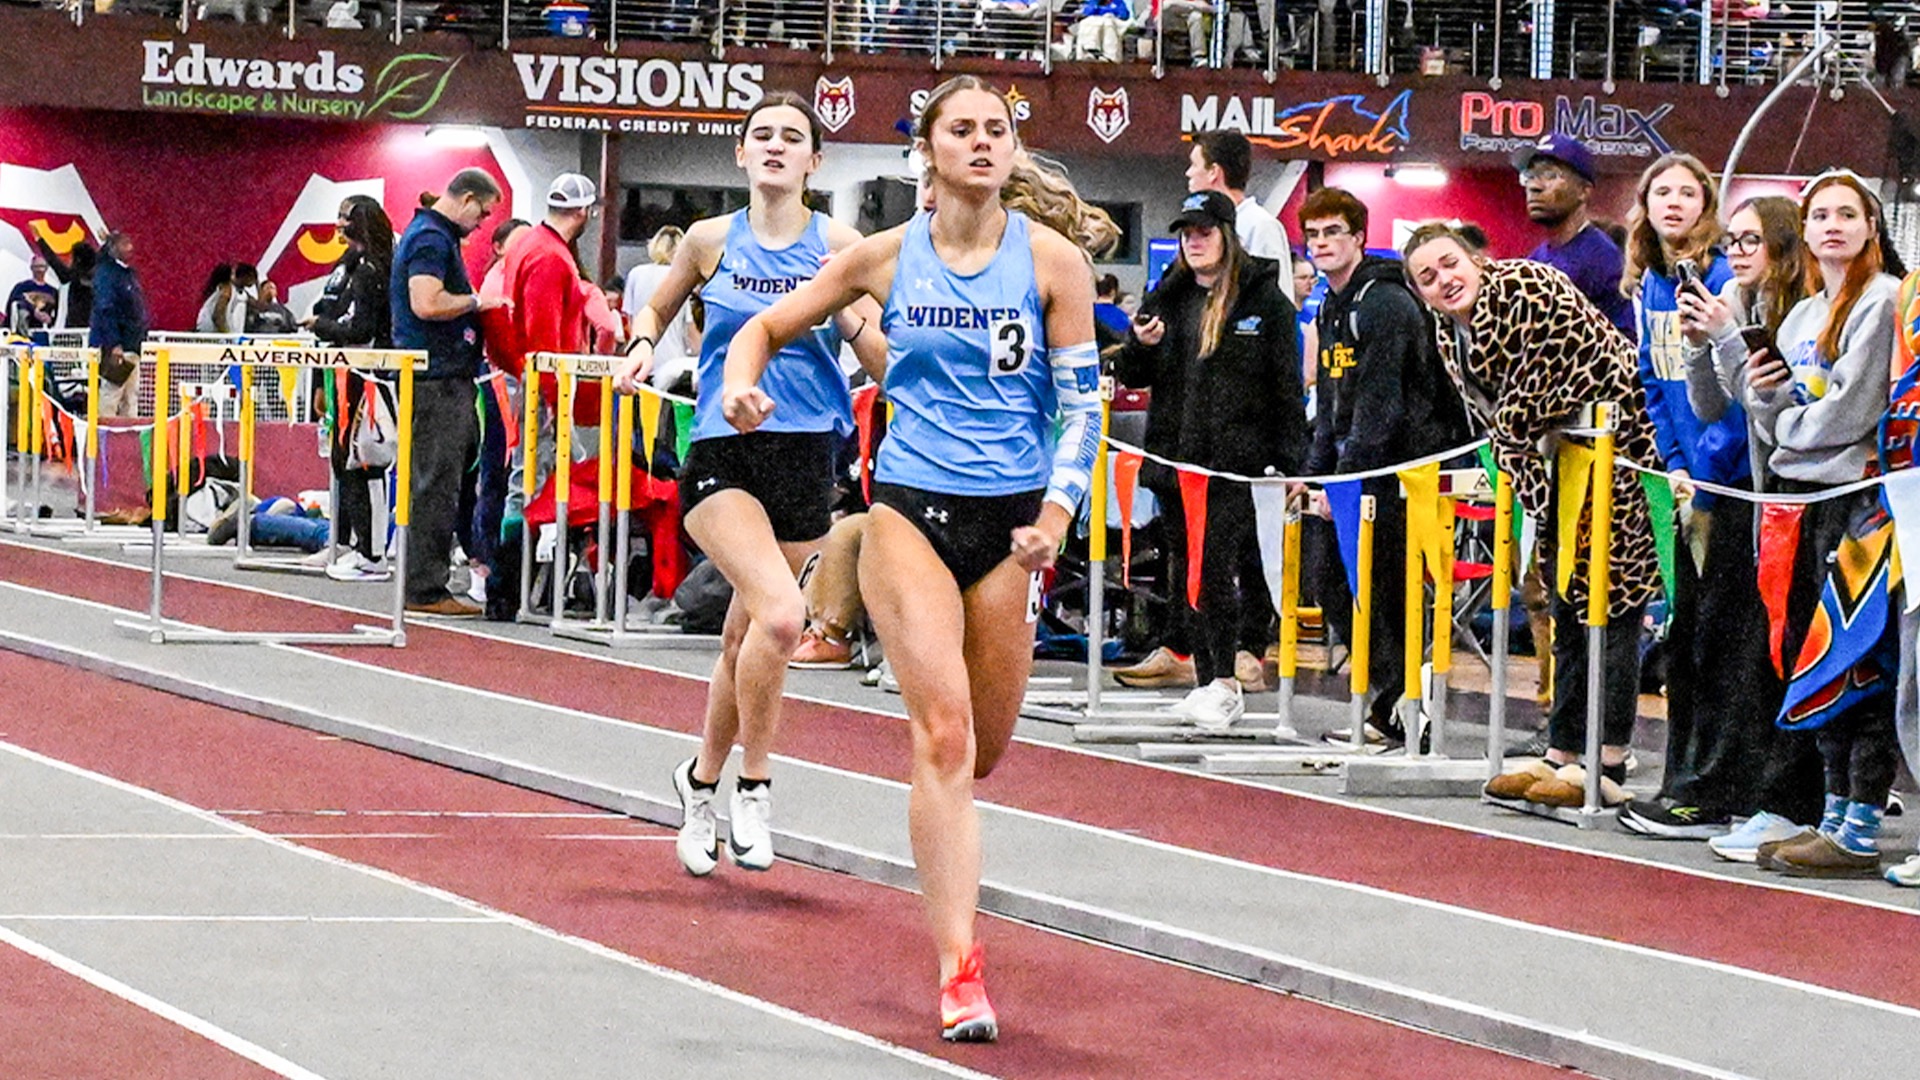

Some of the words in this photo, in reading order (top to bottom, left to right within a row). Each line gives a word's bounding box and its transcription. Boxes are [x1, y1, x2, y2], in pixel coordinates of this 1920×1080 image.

[142, 40, 364, 93] Edwards
[512, 53, 764, 110] VISIONS
[142, 86, 257, 113] Landscape
[261, 93, 276, 112] &
[282, 93, 364, 119] Nursery
[526, 115, 611, 131] FEDERAL
[619, 119, 690, 134] CREDIT
[698, 122, 743, 135] UNIO
[1181, 94, 1300, 136] MAIL
[1247, 102, 1396, 157] Shark
[1461, 92, 1543, 137] Pro
[1554, 96, 1674, 156] Max
[732, 273, 813, 294] WIDEN
[906, 305, 1020, 330] WIDENER
[219, 348, 350, 366] ALVERNIA
[997, 322, 1026, 373] 3
